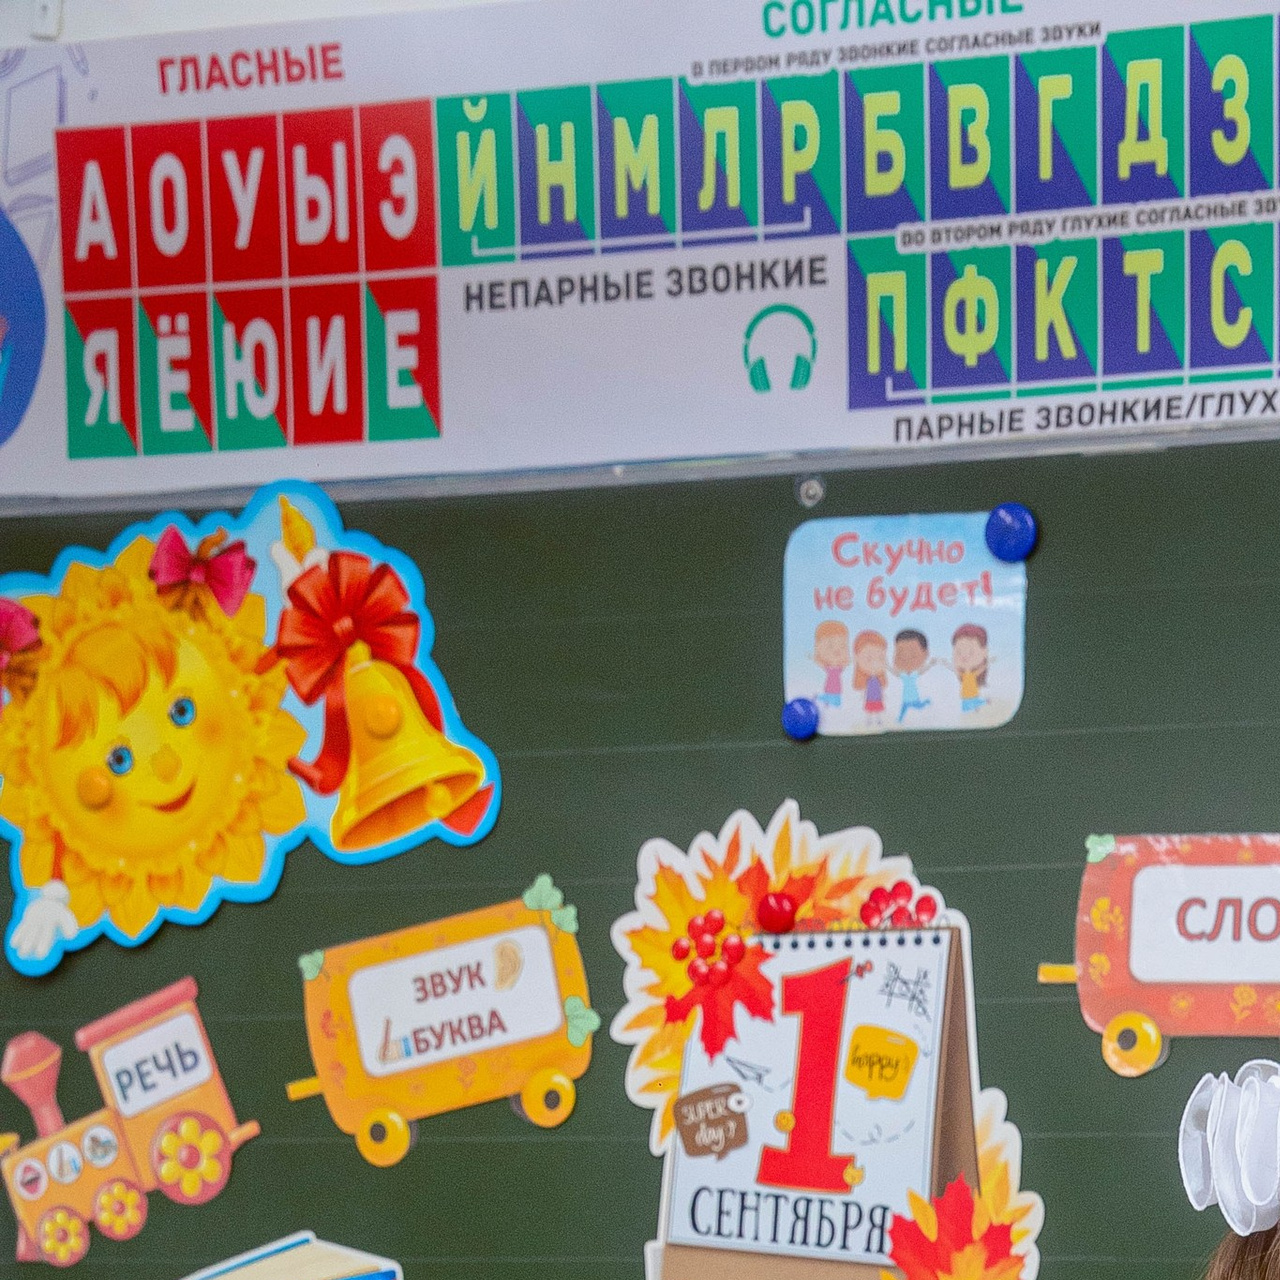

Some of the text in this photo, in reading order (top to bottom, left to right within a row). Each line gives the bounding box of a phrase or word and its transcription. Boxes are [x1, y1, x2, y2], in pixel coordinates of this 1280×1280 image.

[157, 43, 345, 94] ГЛАСНЫЕ
[708, 54, 780, 77] ПЕРВОМ
[785, 48, 832, 69] РЯДУ
[837, 38, 919, 64] ЗВОНКИЕ
[924, 27, 1034, 57] СОГЛАСНЫЕ
[1040, 20, 1101, 41] ЗВУКИ
[901, 231, 926, 248] ВО
[931, 225, 1001, 246] ВТОРОМ
[1007, 218, 1056, 238] РЯДУ
[1060, 211, 1129, 234] ГЛУХИЕ
[1135, 201, 1249, 226] СОГЛАСНЫЕ
[463, 254, 828, 314] НЕПАРНЫЕ ЗВОНКИЕ
[893, 408, 1025, 444] ПАРНЫЕ
[831, 532, 965, 576] Скучно
[814, 570, 992, 618] не будет!
[413, 961, 485, 1003] ЗВУК
[412, 1009, 508, 1054] БУКВА
[115, 1040, 200, 1103] РЕЧЬ
[756, 955, 857, 1194] 1
[690, 1186, 893, 1254] СЕНТЯБРЯ
